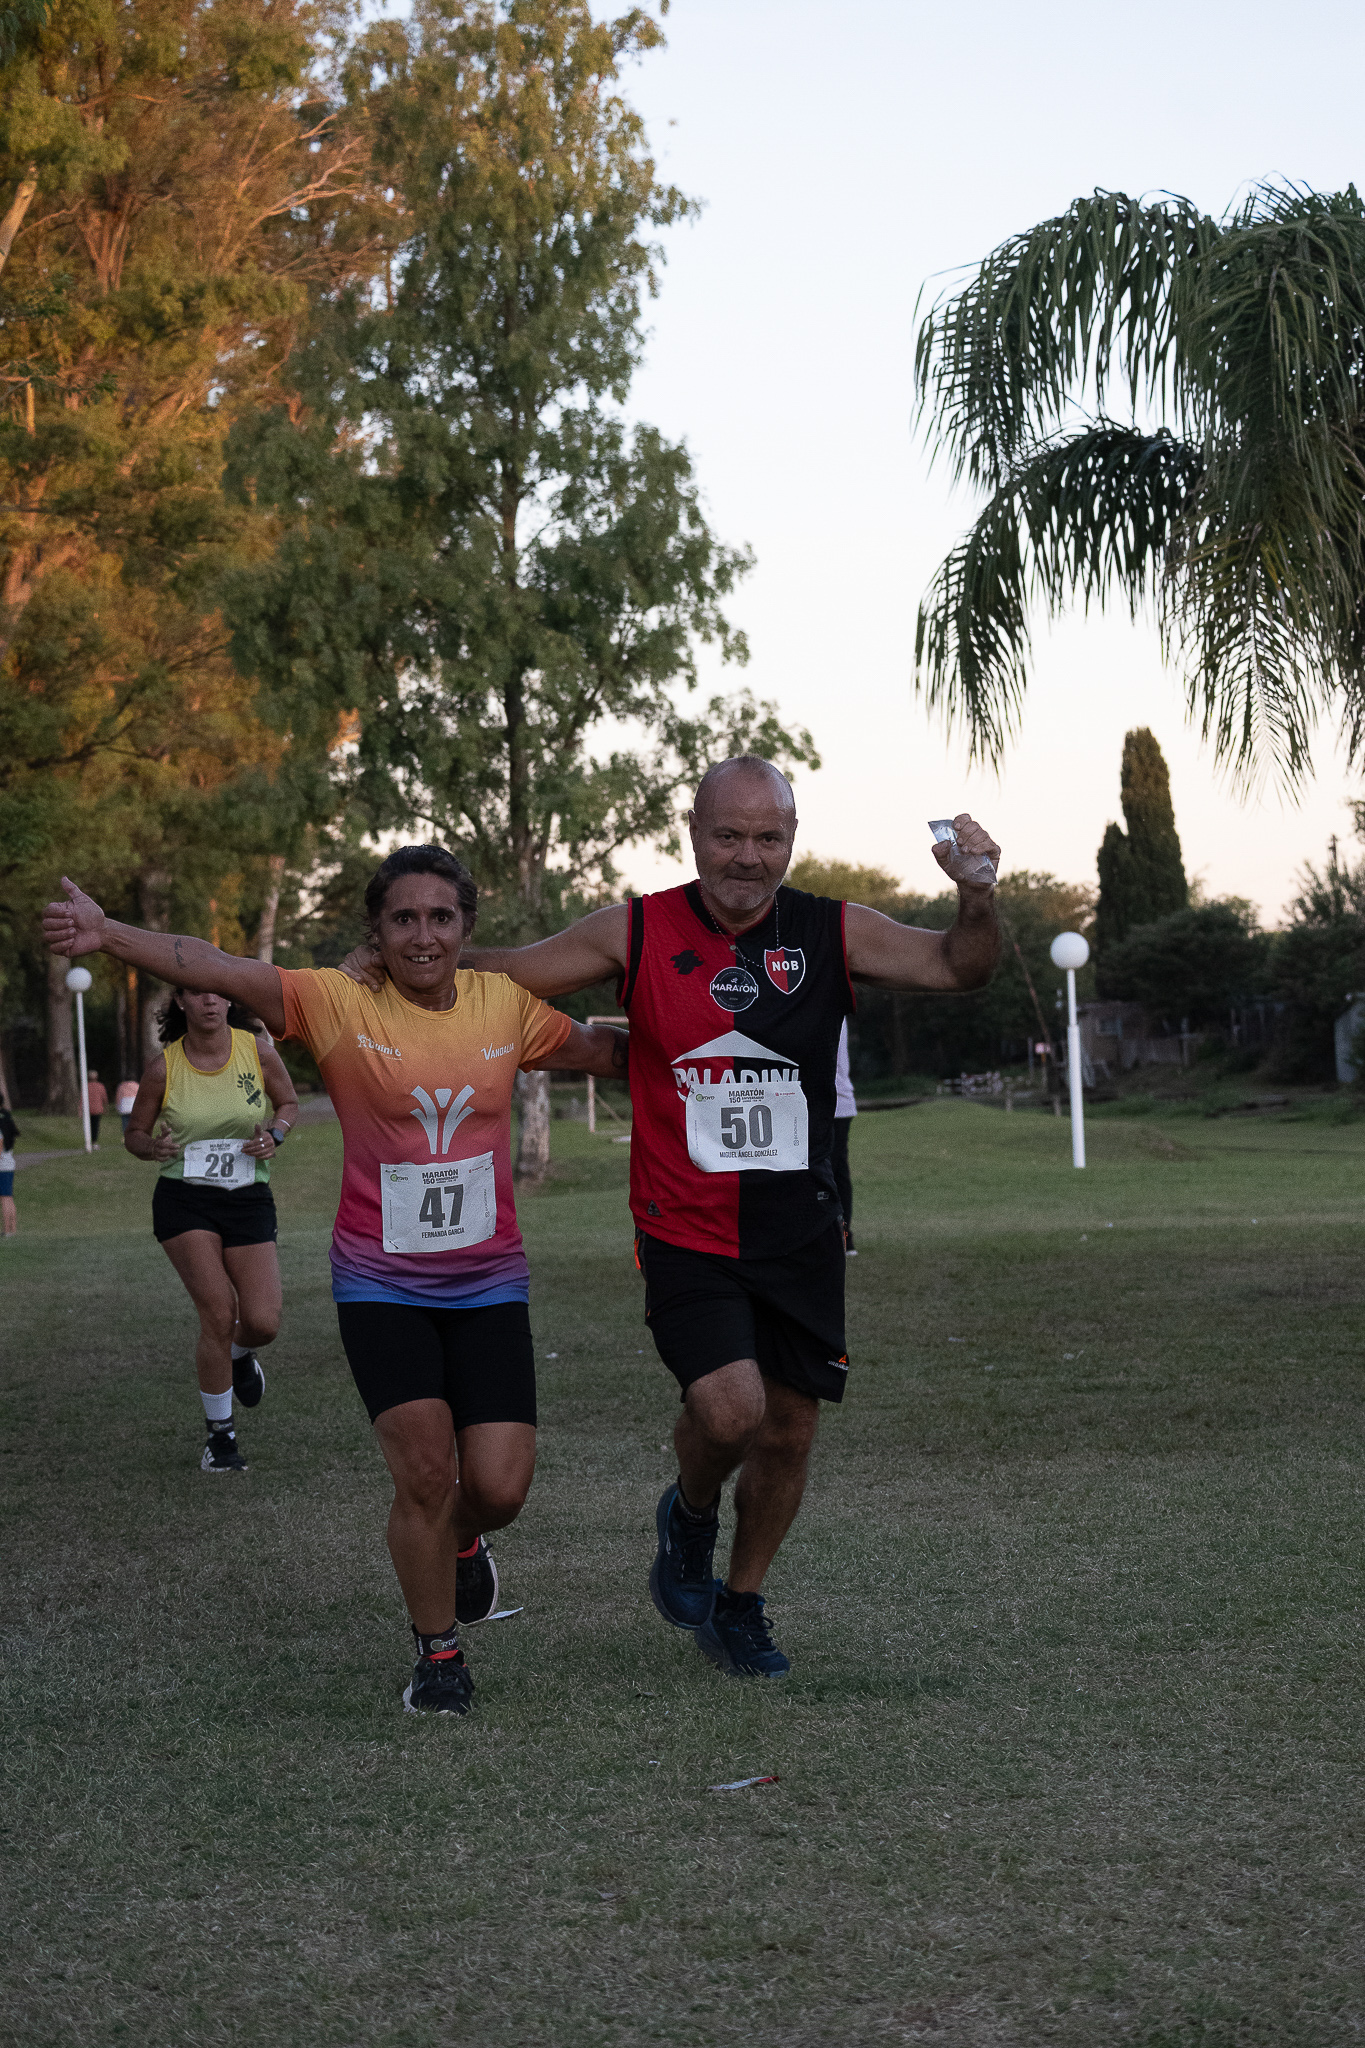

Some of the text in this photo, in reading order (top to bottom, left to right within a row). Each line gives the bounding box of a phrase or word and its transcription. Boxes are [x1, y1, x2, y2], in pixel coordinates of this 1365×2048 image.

[772, 960, 799, 972] NOB
[712, 983, 757, 993] MARATÓN
[728, 1088, 764, 1098] MARATÓN
[721, 1105, 773, 1149] 50
[738, 1150, 754, 1158] ÁNGEL
[754, 1149, 778, 1158] GONZÁLEZ
[205, 1153, 235, 1177] 28
[422, 1168, 458, 1179] MARATÓN
[419, 1184, 464, 1228] 47
[421, 1230, 448, 1239] FERNANDA
